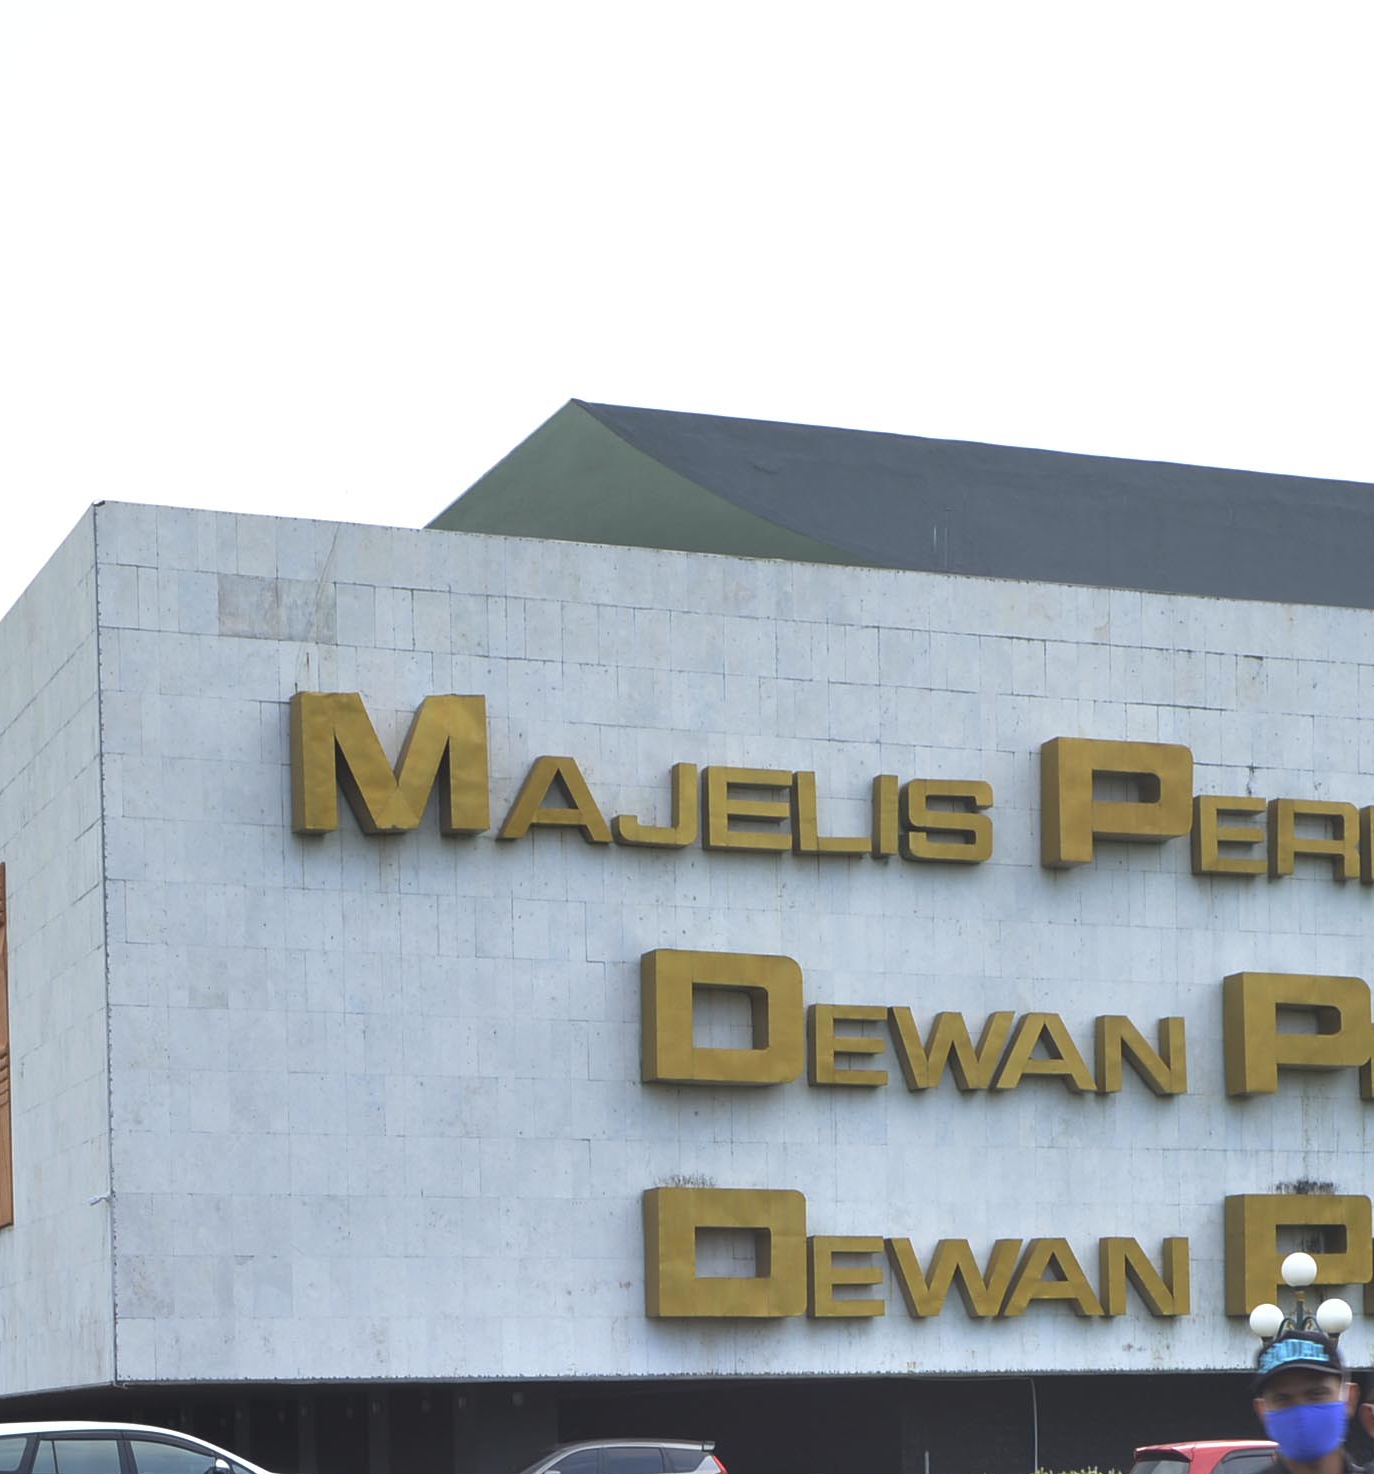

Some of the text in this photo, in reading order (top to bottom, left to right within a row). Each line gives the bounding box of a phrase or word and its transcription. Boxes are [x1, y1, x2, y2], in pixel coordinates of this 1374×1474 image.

[291, 691, 995, 864] MAJELIS
[641, 948, 1188, 1094] DEWAN
[644, 1186, 1191, 1319] DEWAN
